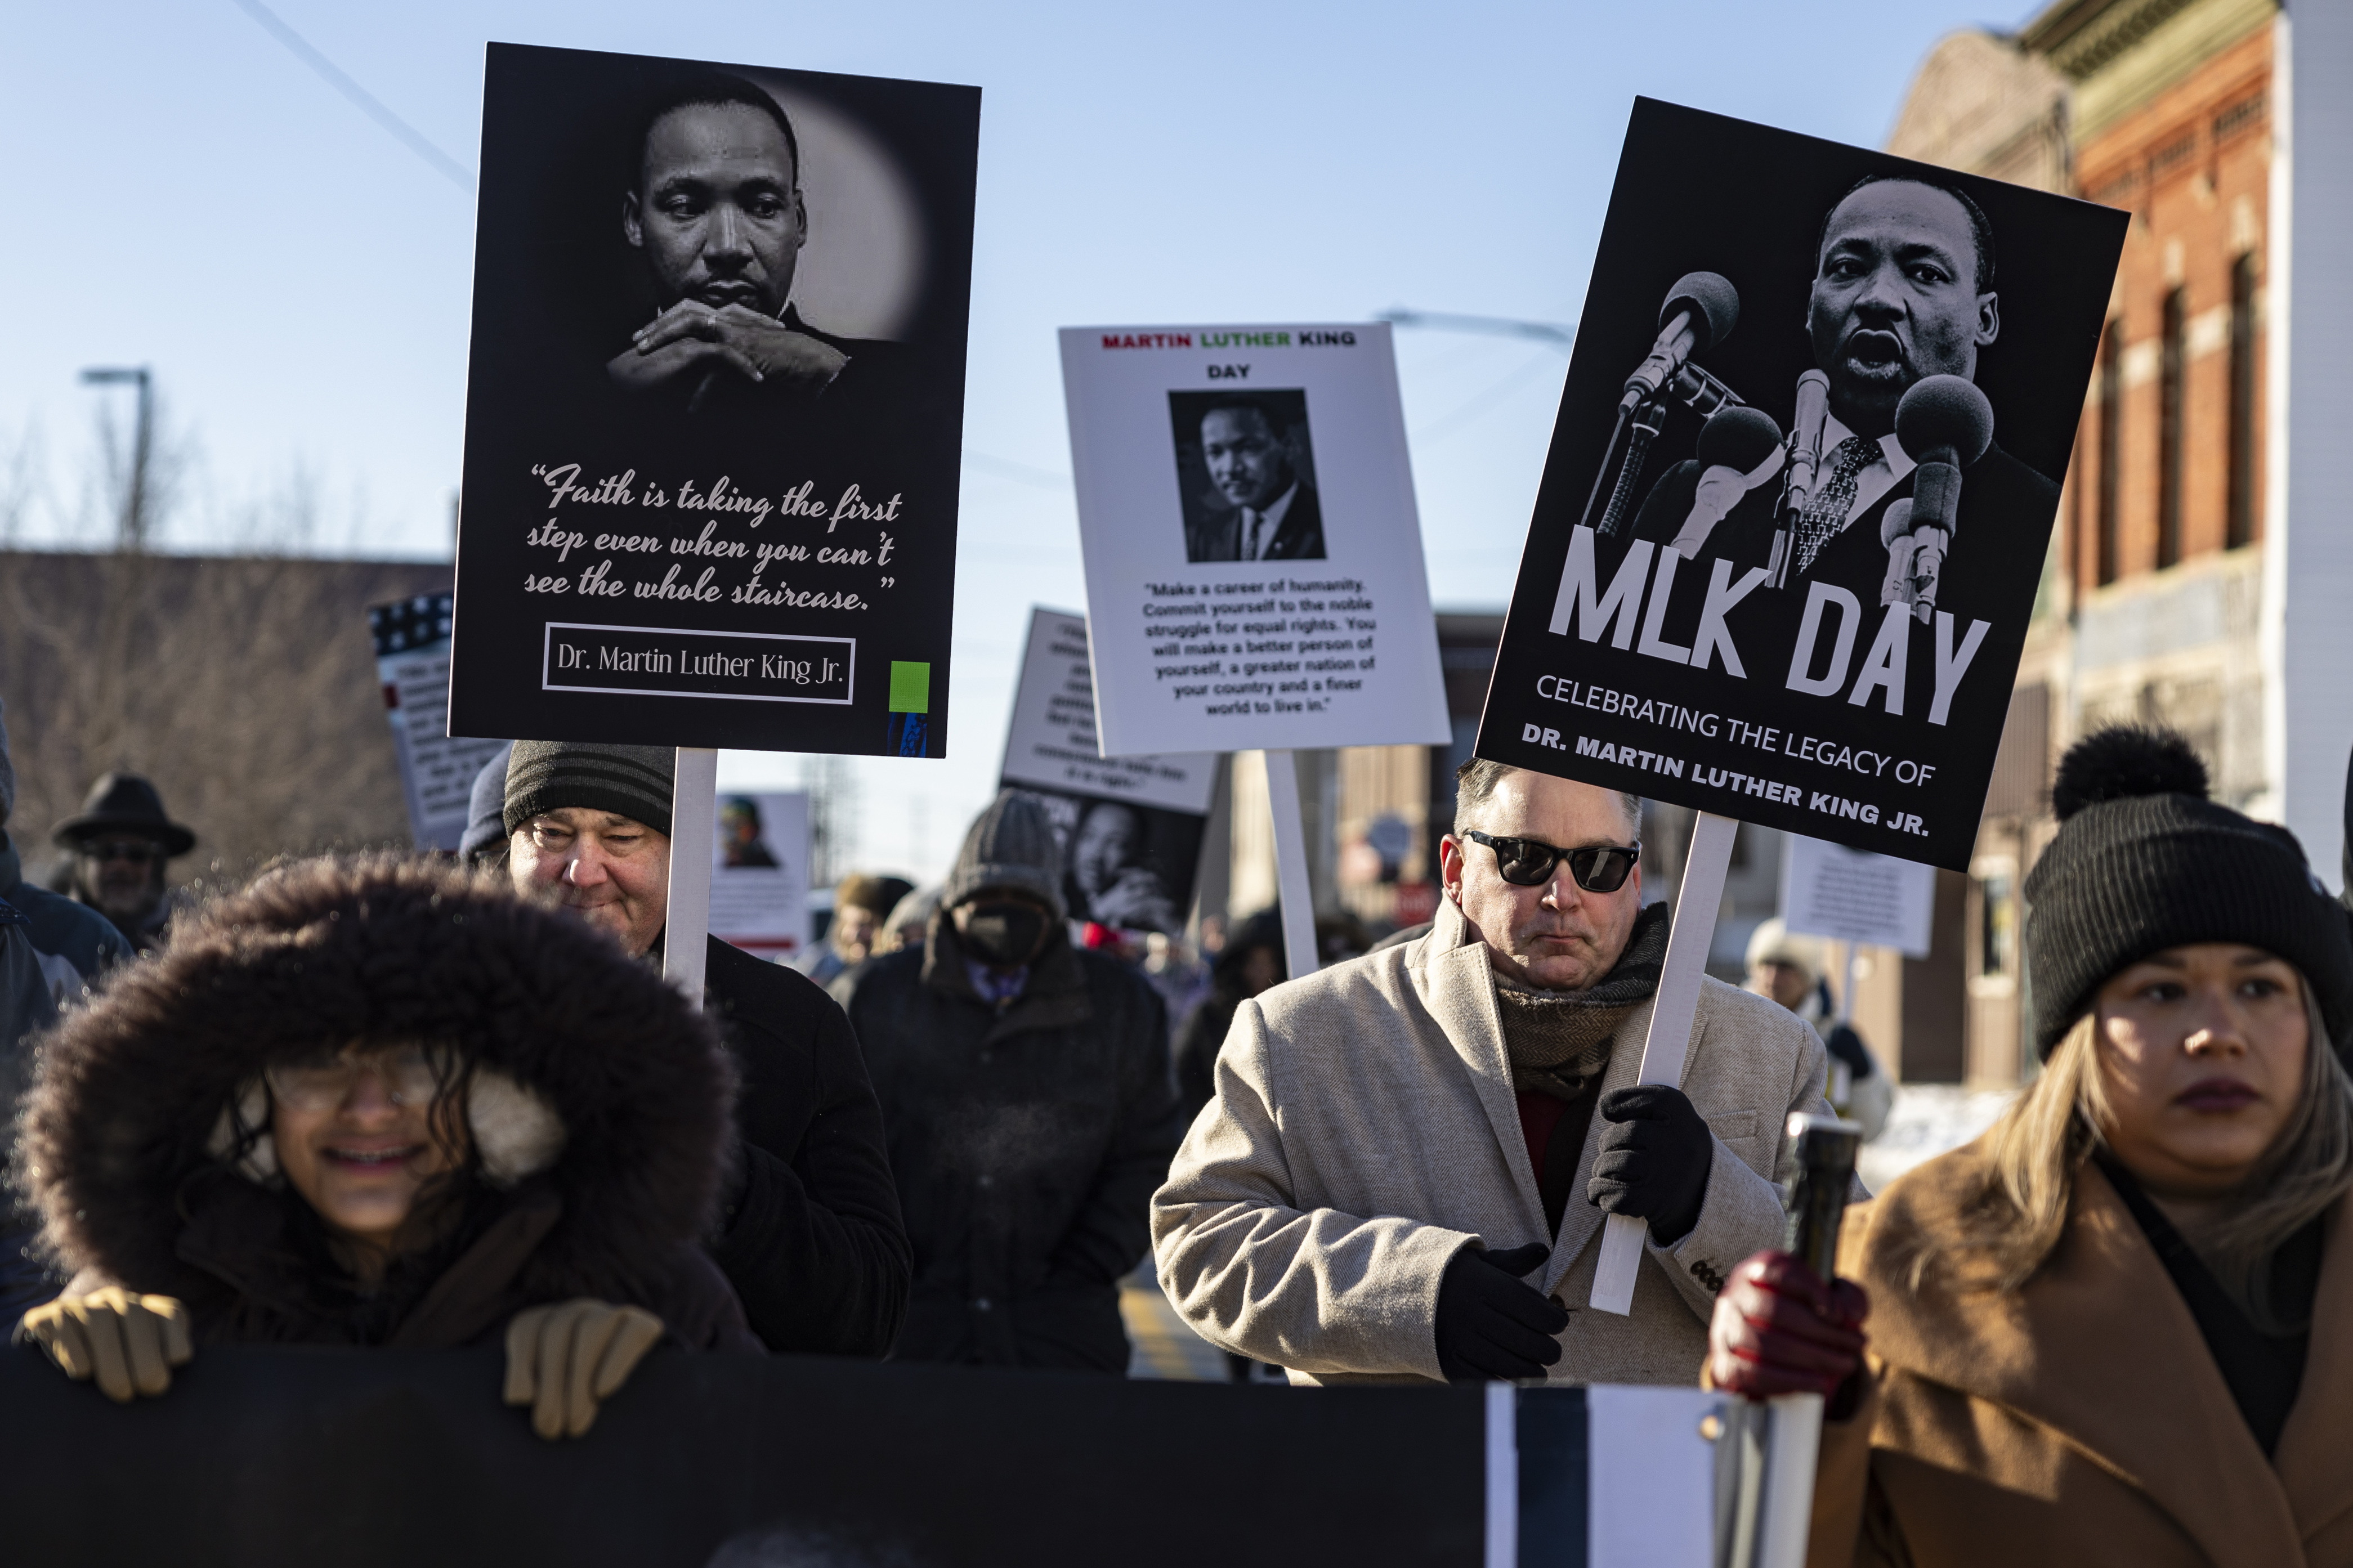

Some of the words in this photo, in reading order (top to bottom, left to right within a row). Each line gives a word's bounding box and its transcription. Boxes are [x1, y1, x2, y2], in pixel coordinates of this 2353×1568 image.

[1102, 333, 1192, 350] MARTIN
[1200, 331, 1291, 348] LUTHER
[1299, 331, 1357, 347] KING
[1207, 364, 1250, 380] DAY
[531, 463, 636, 509] “Faith
[642, 482, 670, 508] is
[677, 475, 774, 528] taking
[781, 480, 828, 517] the
[827, 483, 903, 534] first
[527, 517, 588, 562] step
[594, 534, 663, 553] even
[670, 521, 750, 558] when
[753, 543, 809, 575] you
[817, 531, 895, 566] can’t
[524, 574, 571, 594] see
[578, 559, 627, 597] the
[634, 563, 723, 602] whole
[1201, 585, 1211, 595] a
[1214, 581, 1265, 595] career
[1269, 579, 1285, 594] of
[1143, 603, 1207, 617] Commit
[1211, 599, 1275, 616] yourself
[1280, 600, 1296, 612] to
[1299, 598, 1325, 612] the
[1329, 598, 1373, 611] noble
[1145, 621, 1211, 638] struggle
[1216, 620, 1238, 634] for
[1243, 620, 1287, 635] equal
[1346, 618, 1377, 631] You
[1548, 523, 1772, 679] MLK
[1785, 580, 1992, 726] DAY
[1153, 642, 1180, 657] will
[1184, 641, 1228, 656] make
[1233, 643, 1243, 653] a
[1246, 639, 1293, 653] better
[1298, 638, 1353, 654] person
[1357, 636, 1374, 650] of
[558, 644, 591, 669] Dr.
[599, 646, 672, 673] Martin
[680, 650, 754, 677] Luther
[761, 654, 812, 684] King
[815, 657, 843, 684] Jr.
[1229, 664, 1240, 675] a
[1243, 660, 1300, 675] greater
[1305, 657, 1355, 672] nation
[1359, 656, 1376, 670] of
[1174, 684, 1209, 700] your
[1213, 682, 1274, 697] country
[1279, 678, 1308, 692] and
[1312, 680, 1322, 691] a
[1326, 677, 1362, 691] finer
[1206, 701, 1250, 715] world
[1255, 702, 1271, 714] to
[1274, 699, 1303, 713] live
[1537, 675, 1719, 737] CELEBRATING
[1727, 718, 1780, 752] THE
[1784, 733, 1891, 777] LEGACY
[1895, 760, 1936, 786] OF
[1522, 723, 1567, 751] DR.
[1575, 736, 1685, 778] MARTIN
[1692, 763, 1802, 807] LUTHER
[1809, 791, 1880, 825] KING
[1887, 812, 1929, 837] JR.
